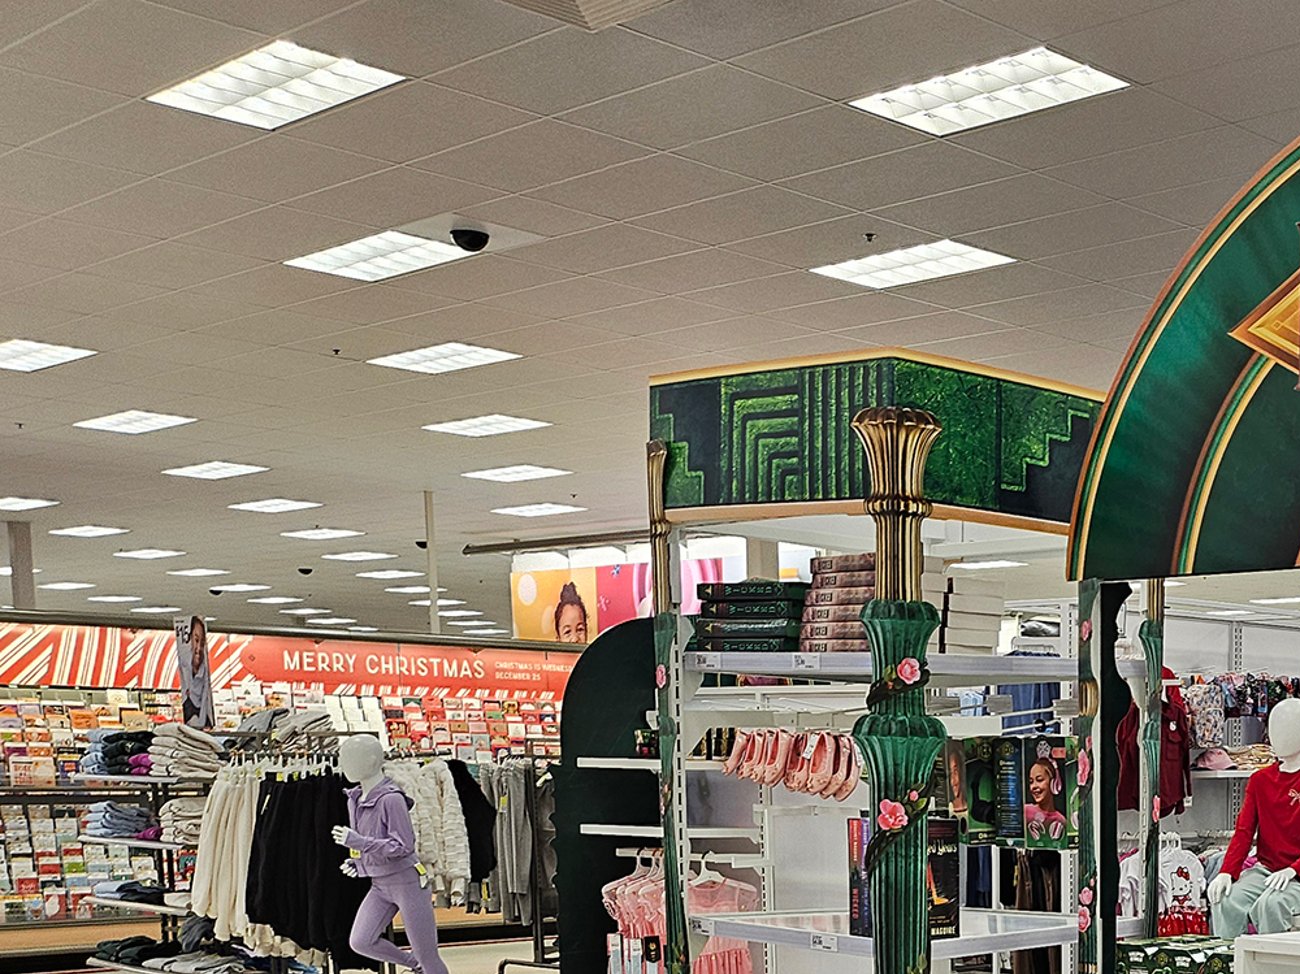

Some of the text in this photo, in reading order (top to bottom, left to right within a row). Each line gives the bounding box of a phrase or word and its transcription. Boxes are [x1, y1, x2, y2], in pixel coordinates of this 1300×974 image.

[725, 585, 773, 594] WICKED
[728, 604, 777, 614] WICKED
[723, 642, 770, 651] WICKED
[283, 649, 485, 679] MERRY CHRISTMAS
[495, 661, 532, 671] CHRISTMAS
[495, 671, 530, 680] DECEMBER
